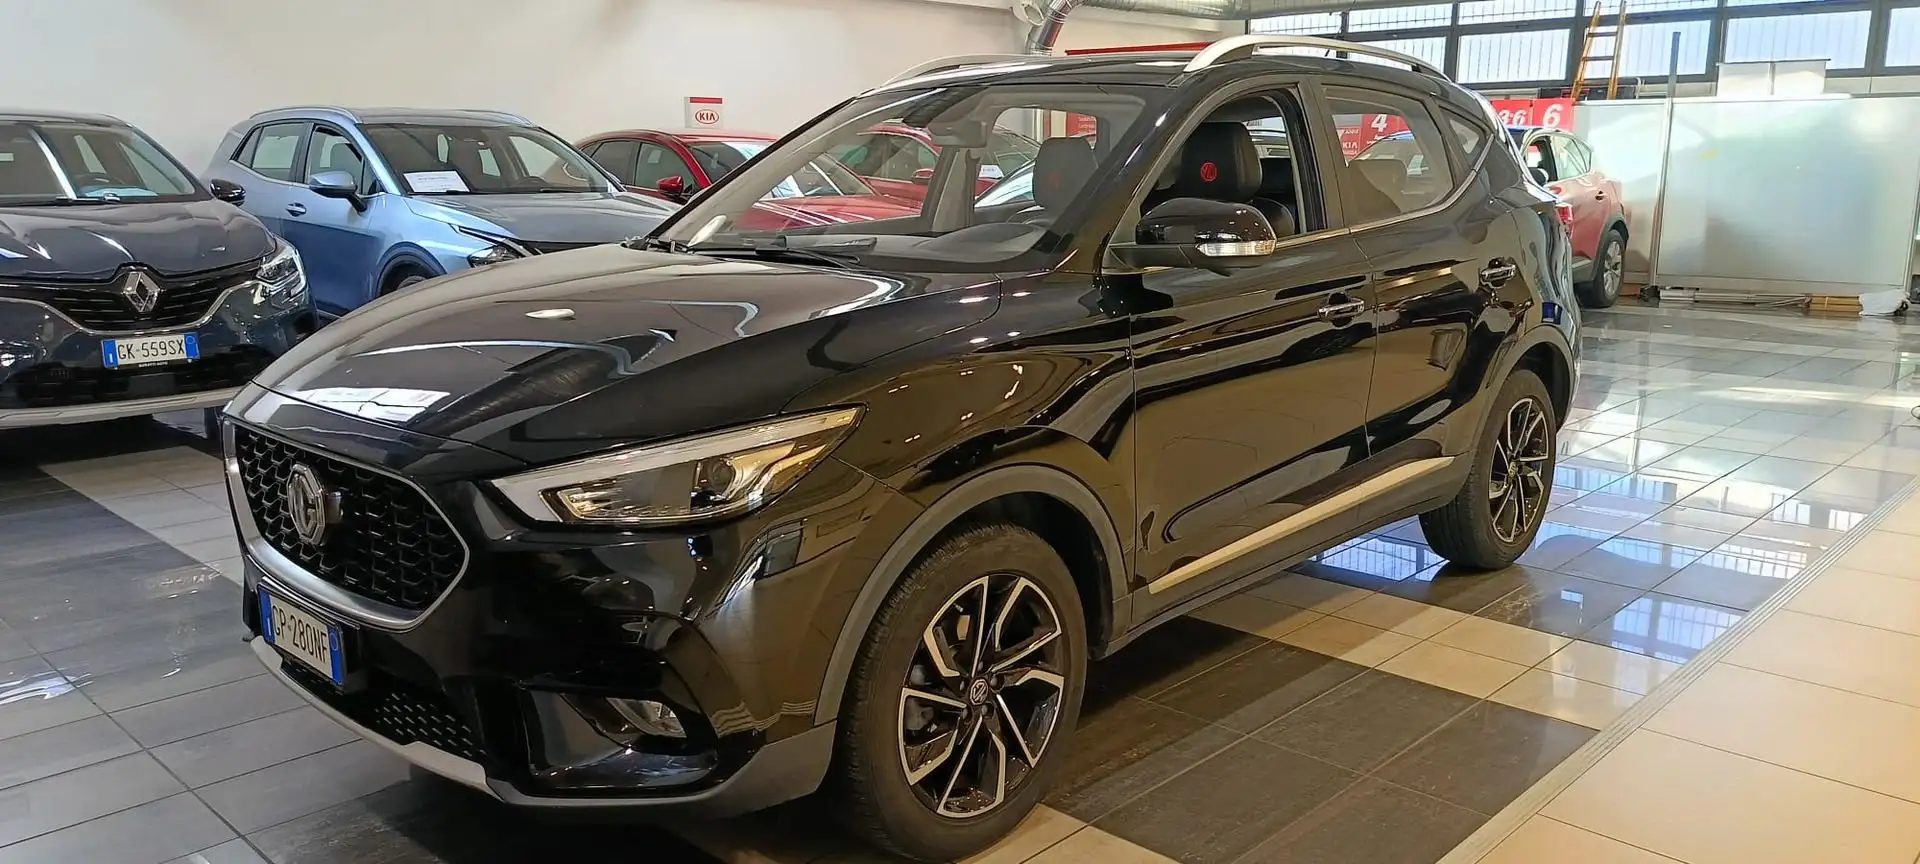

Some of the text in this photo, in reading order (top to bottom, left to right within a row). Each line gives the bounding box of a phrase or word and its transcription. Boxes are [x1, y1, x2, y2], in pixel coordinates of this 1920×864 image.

[699, 112, 716, 121] KIA
[1543, 104, 1563, 128] 6
[1371, 114, 1388, 132] 4
[1342, 141, 1358, 149] KIA
